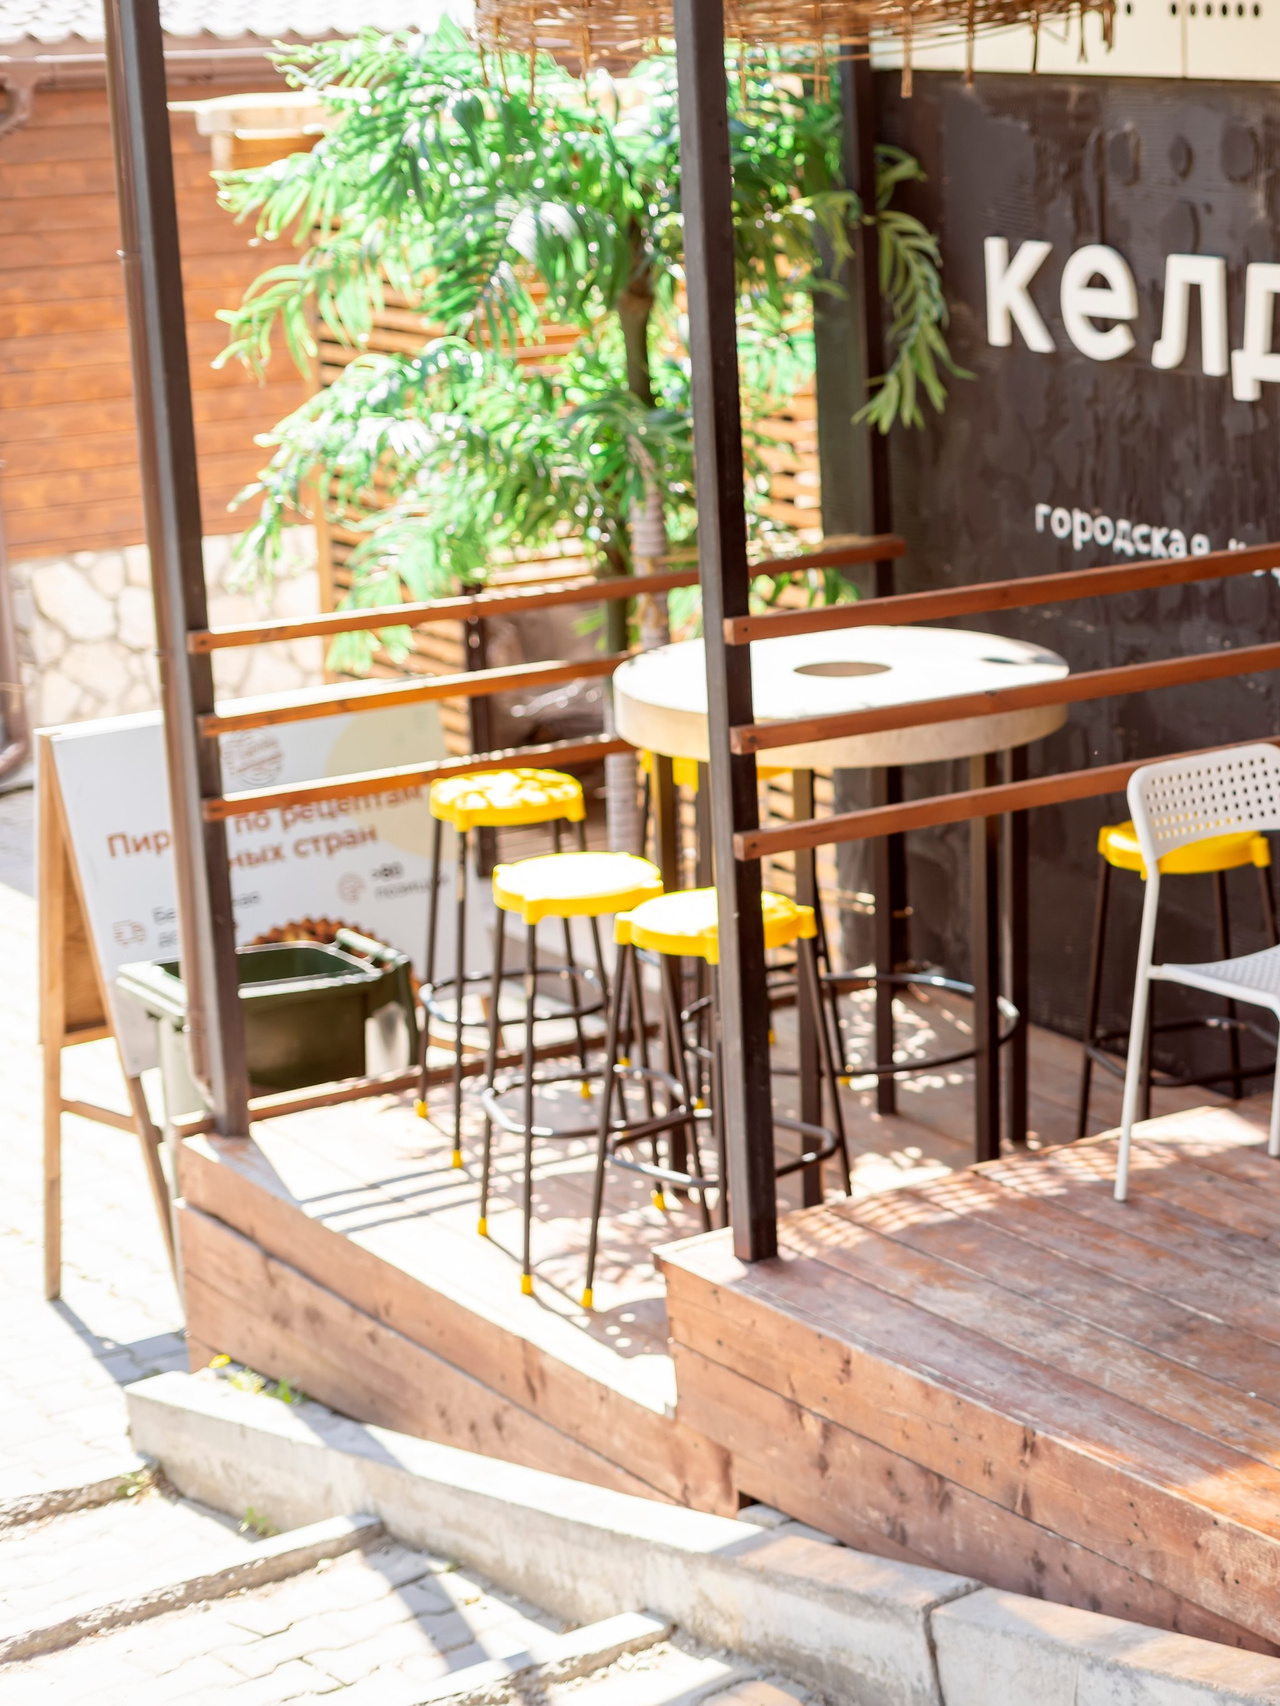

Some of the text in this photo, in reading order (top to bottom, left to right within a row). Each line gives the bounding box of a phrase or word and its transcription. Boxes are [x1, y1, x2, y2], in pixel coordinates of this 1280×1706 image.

[1035, 503, 1211, 559] городская
[107, 786, 424, 859] Пир по рецептам
[228, 825, 379, 869] ных стран
